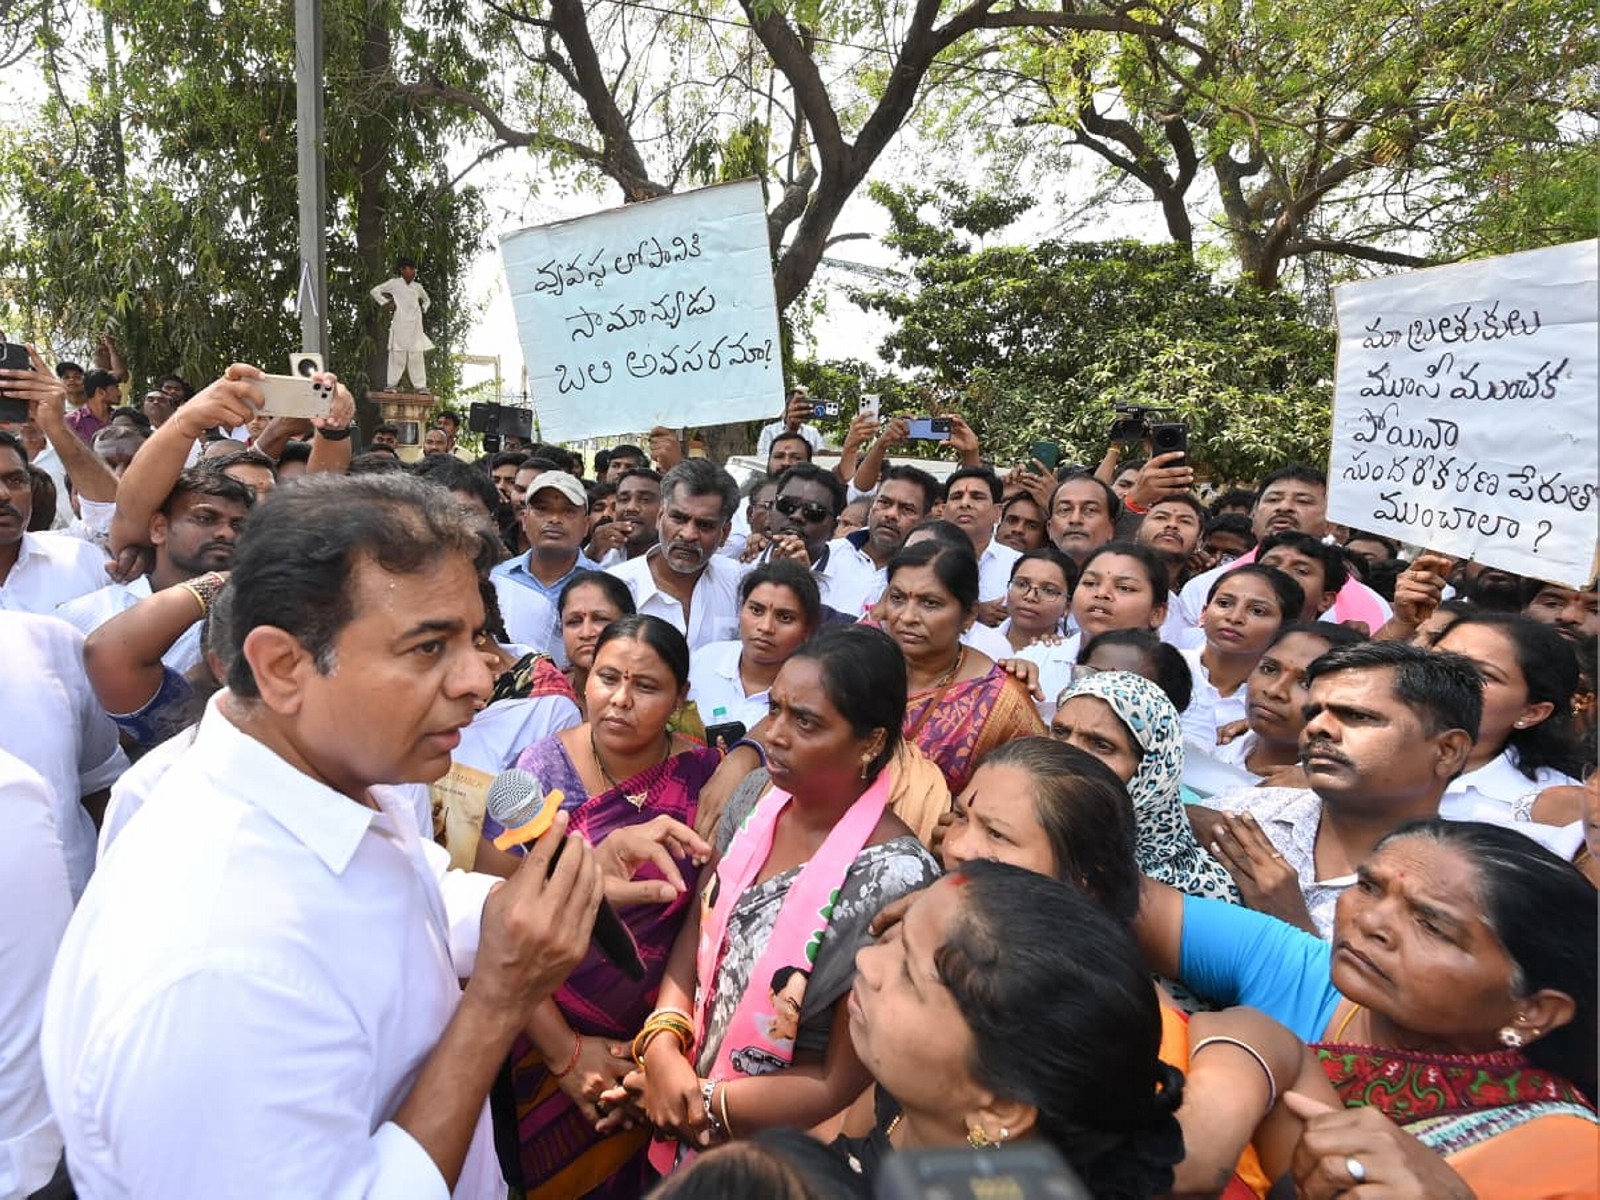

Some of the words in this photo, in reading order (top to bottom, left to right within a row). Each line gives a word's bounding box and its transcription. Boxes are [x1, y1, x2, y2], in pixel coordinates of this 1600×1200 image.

[535, 248, 606, 296] వ్యవస్థ
[615, 233, 701, 275] లోపానికి
[566, 286, 716, 342] సామాన్యుడు
[1363, 317, 1402, 349] మా
[1407, 300, 1542, 352] బ్రతుకులు
[555, 363, 612, 394] బలి
[1360, 352, 1454, 398] మూసీ
[1450, 357, 1570, 401] ముంచక
[1352, 402, 1460, 451] పోయినా
